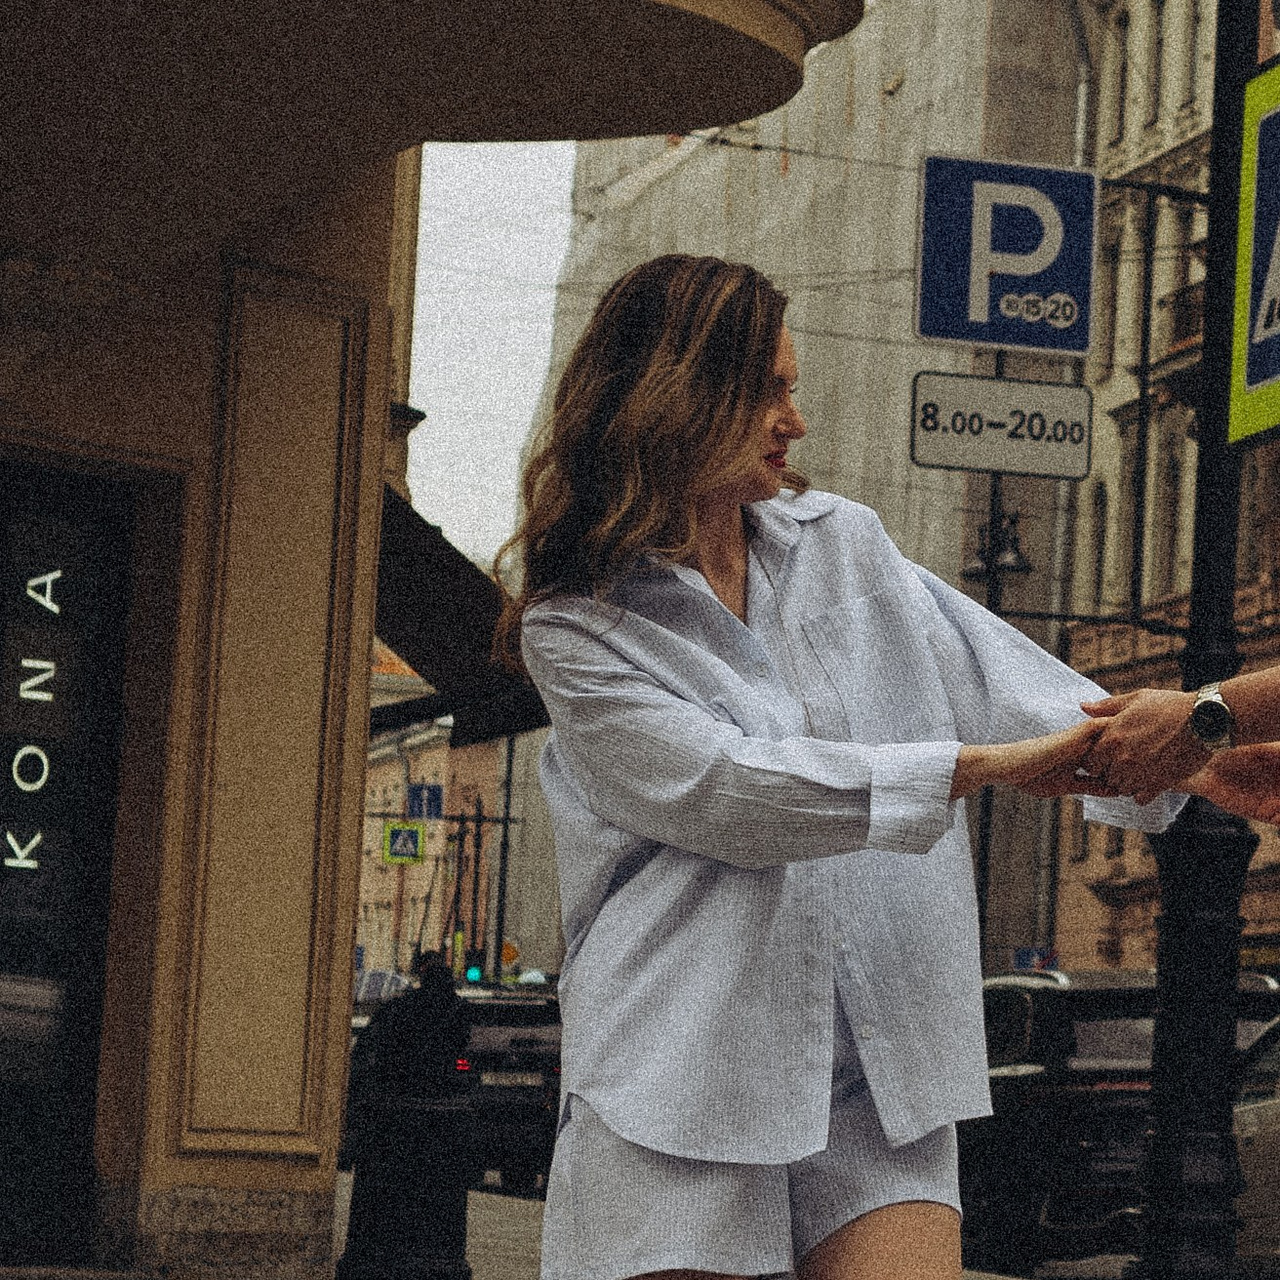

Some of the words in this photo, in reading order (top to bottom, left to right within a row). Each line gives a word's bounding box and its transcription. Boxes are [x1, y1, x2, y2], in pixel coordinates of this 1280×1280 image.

[968, 180, 1064, 323] P
[1048, 299, 1075, 321] 20
[4, 569, 62, 869] KONA
